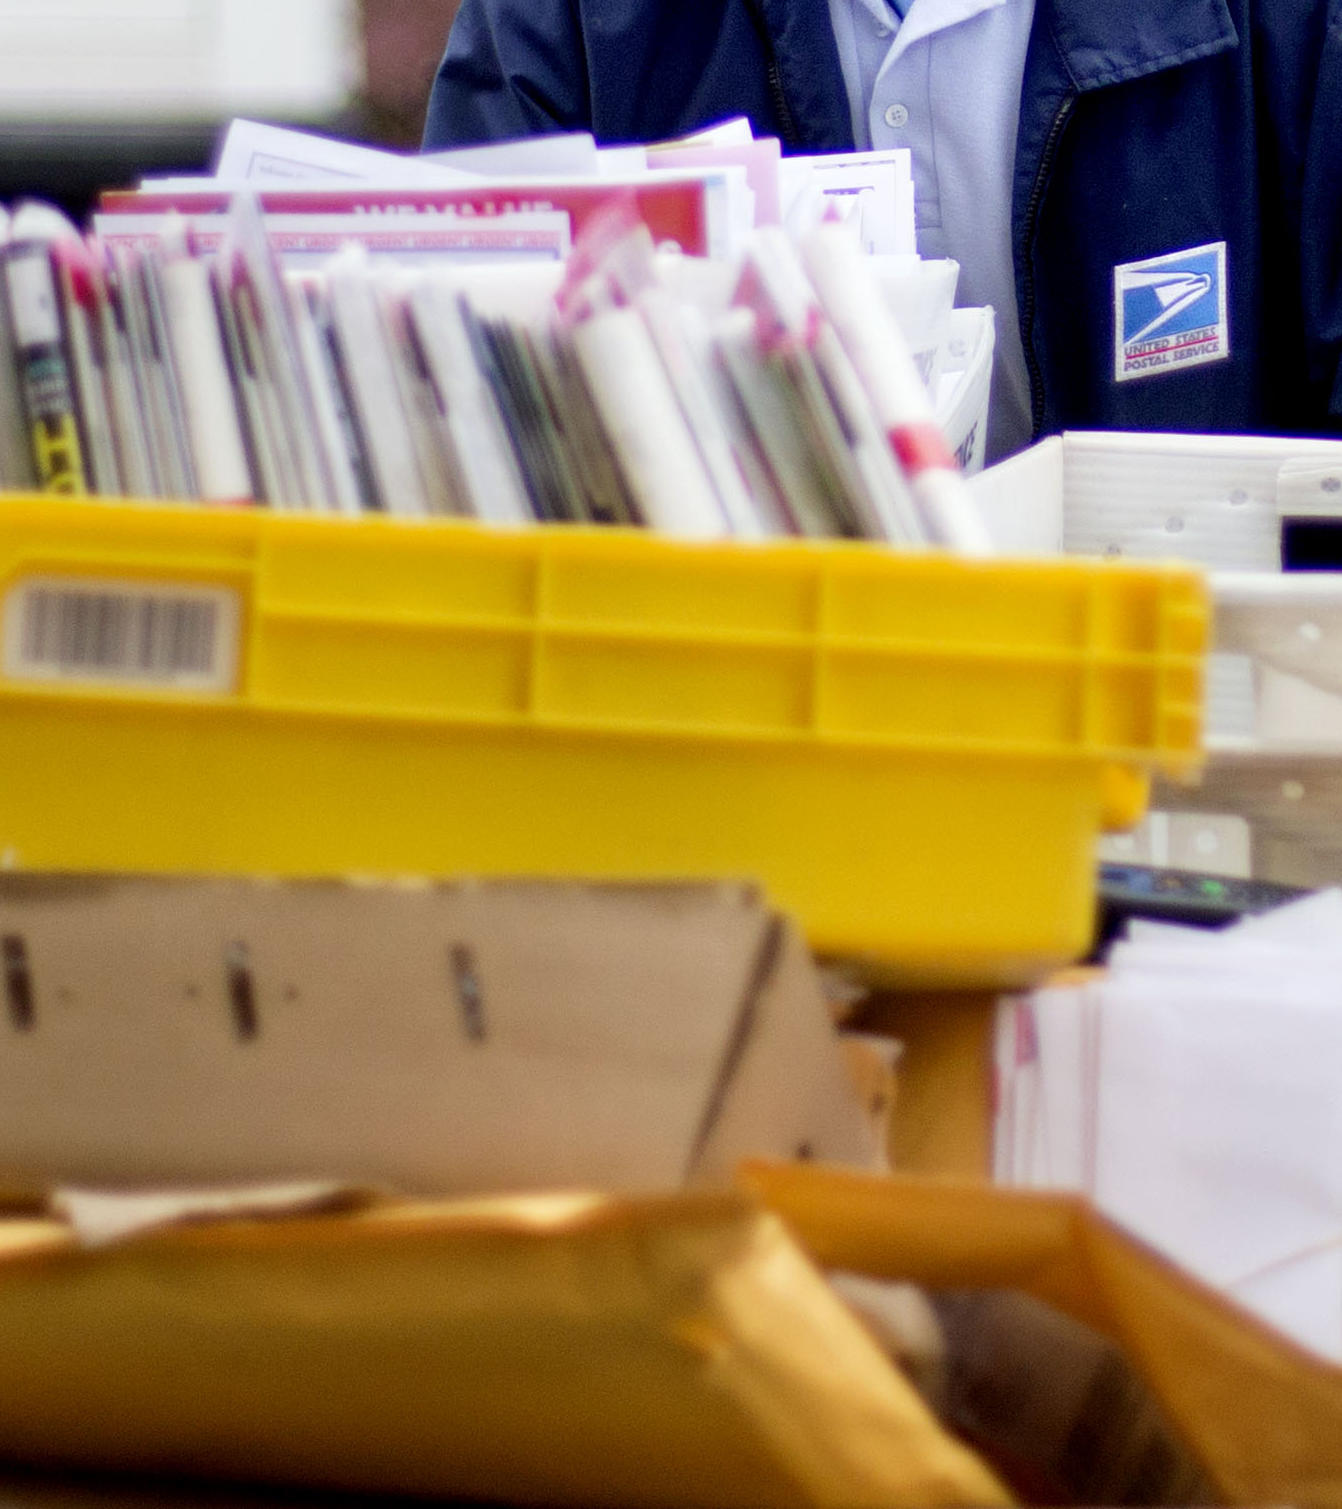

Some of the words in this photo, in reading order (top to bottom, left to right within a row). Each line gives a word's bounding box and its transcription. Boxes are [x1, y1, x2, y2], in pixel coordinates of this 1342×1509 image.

[1124, 339, 1169, 355] UNITED
[1176, 327, 1216, 343] STATES
[1124, 354, 1170, 372] POSTAL
[1173, 342, 1219, 360] SERVICE
